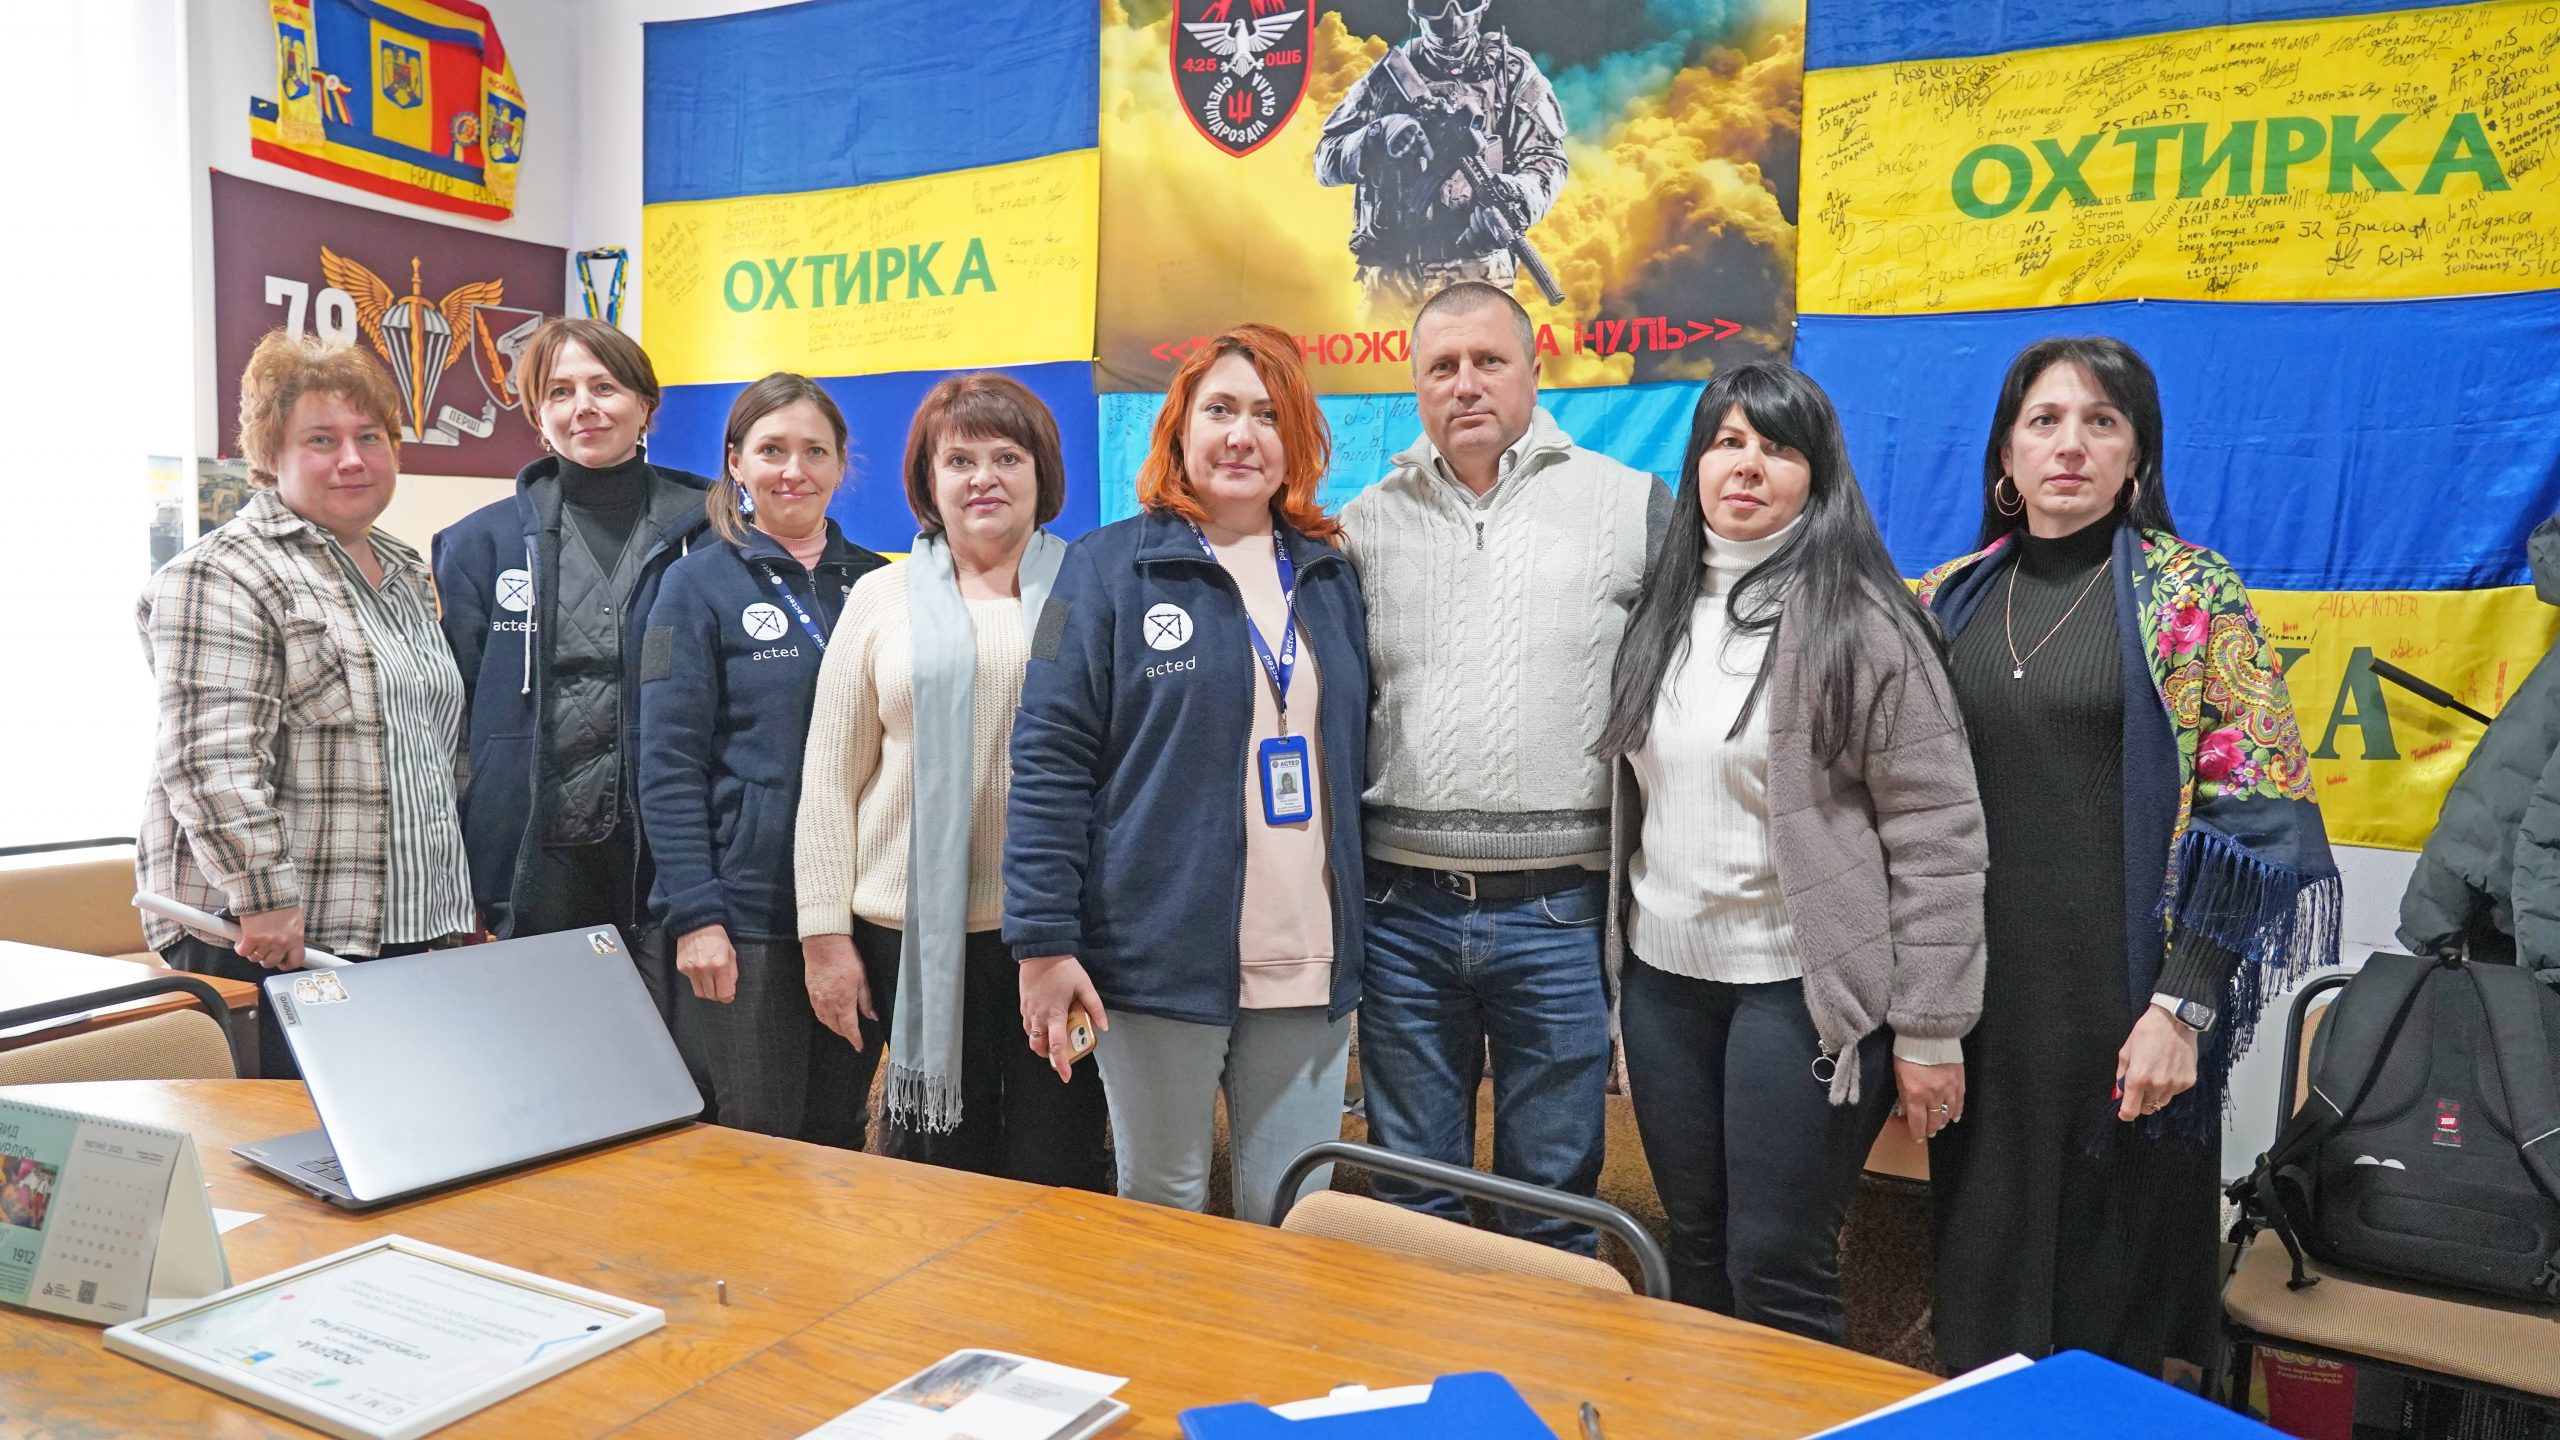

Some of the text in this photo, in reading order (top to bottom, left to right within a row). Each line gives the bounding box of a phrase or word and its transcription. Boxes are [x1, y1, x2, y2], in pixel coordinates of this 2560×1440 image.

[1182, 57, 1218, 72] 425
[1265, 49, 1302, 67] ОШБ
[1251, 72, 1276, 117] СКАЛА
[1951, 113, 2513, 219] ОХТИРКА
[724, 238, 997, 313] ОХТИРКА
[449, 409, 482, 433] ПЕРШІ
[752, 645, 799, 661] acted
[1145, 656, 1196, 678] acted
[1280, 759, 1300, 767] ACTED
[279, 994, 297, 1026] Lenovo
